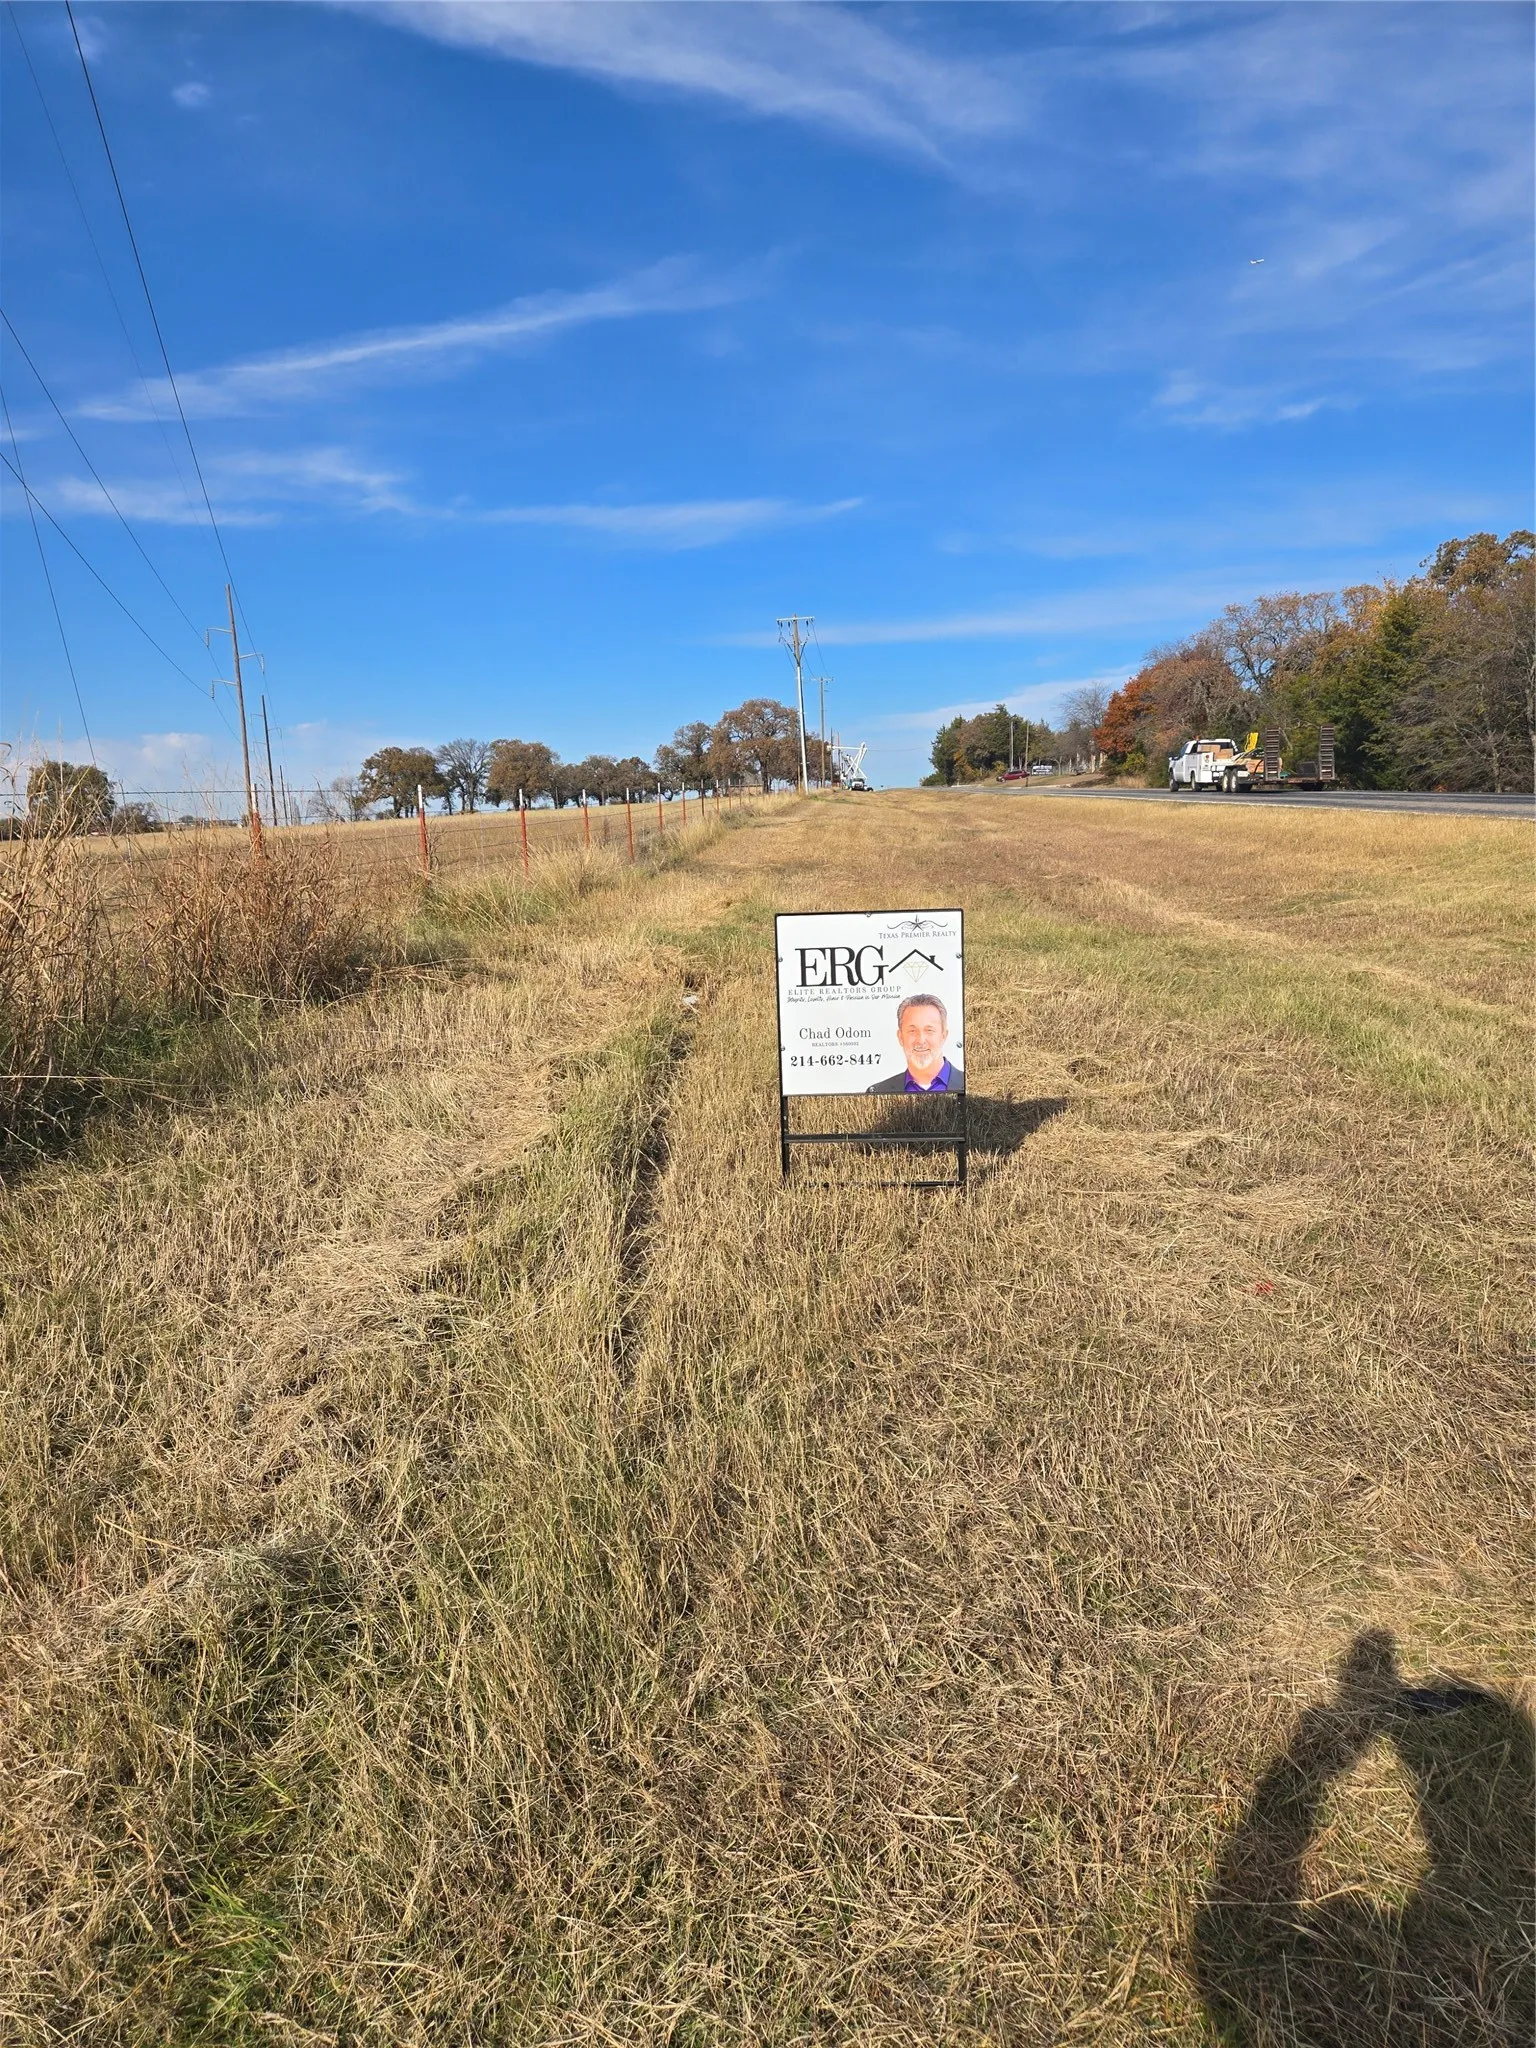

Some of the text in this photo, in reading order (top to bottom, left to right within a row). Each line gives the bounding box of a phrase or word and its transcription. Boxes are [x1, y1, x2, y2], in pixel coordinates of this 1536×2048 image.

[794, 945, 889, 987] ERG
[819, 987, 867, 995] REALTORS
[870, 985, 902, 993] GROUP
[799, 1026, 871, 1039] Chad Odom
[790, 1053, 882, 1067] 214-662-8447
